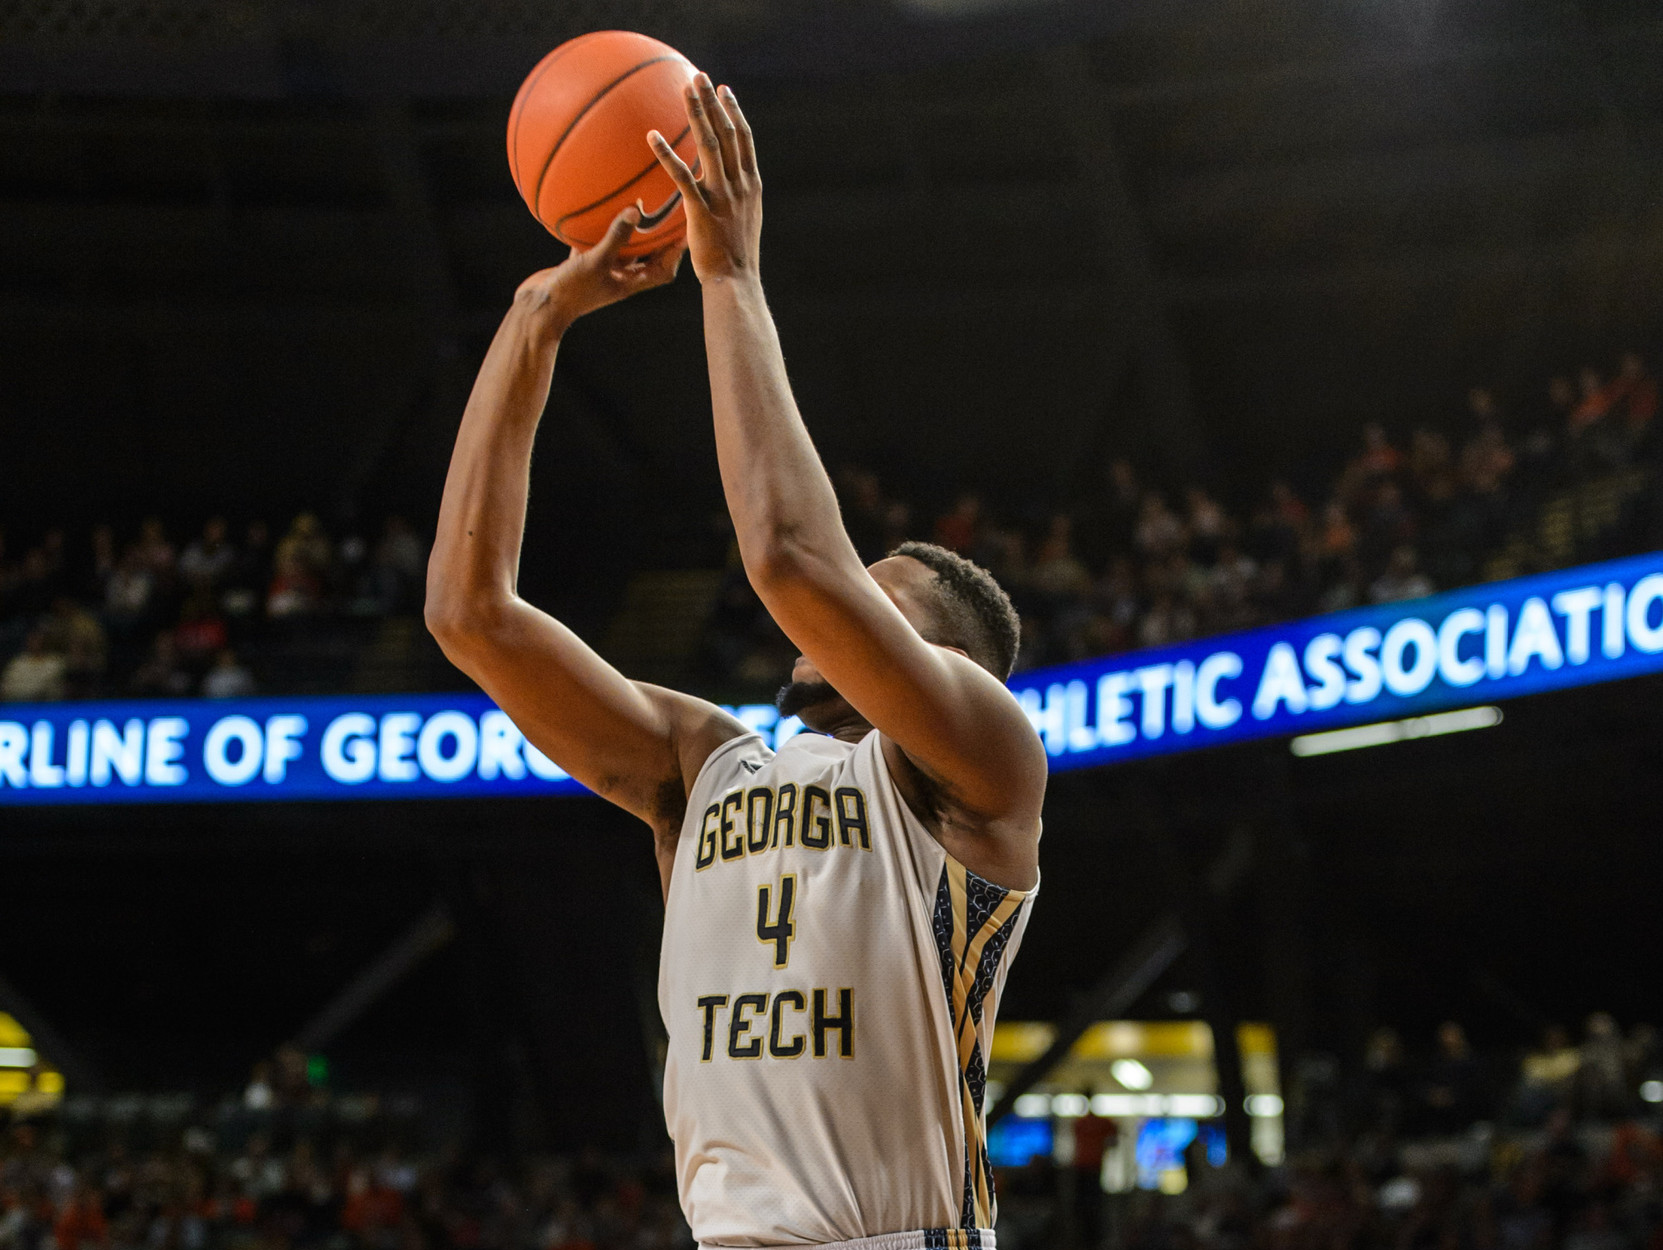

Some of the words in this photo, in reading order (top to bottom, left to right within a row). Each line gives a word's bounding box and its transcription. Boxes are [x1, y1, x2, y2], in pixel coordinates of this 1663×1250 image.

[203, 714, 308, 785] OF
[1012, 652, 1243, 757] HLETIC
[1252, 572, 1663, 720] ASSOCIATIO
[696, 782, 872, 872] GEORGA
[757, 873, 797, 969] 4
[698, 988, 854, 1063] TECH
